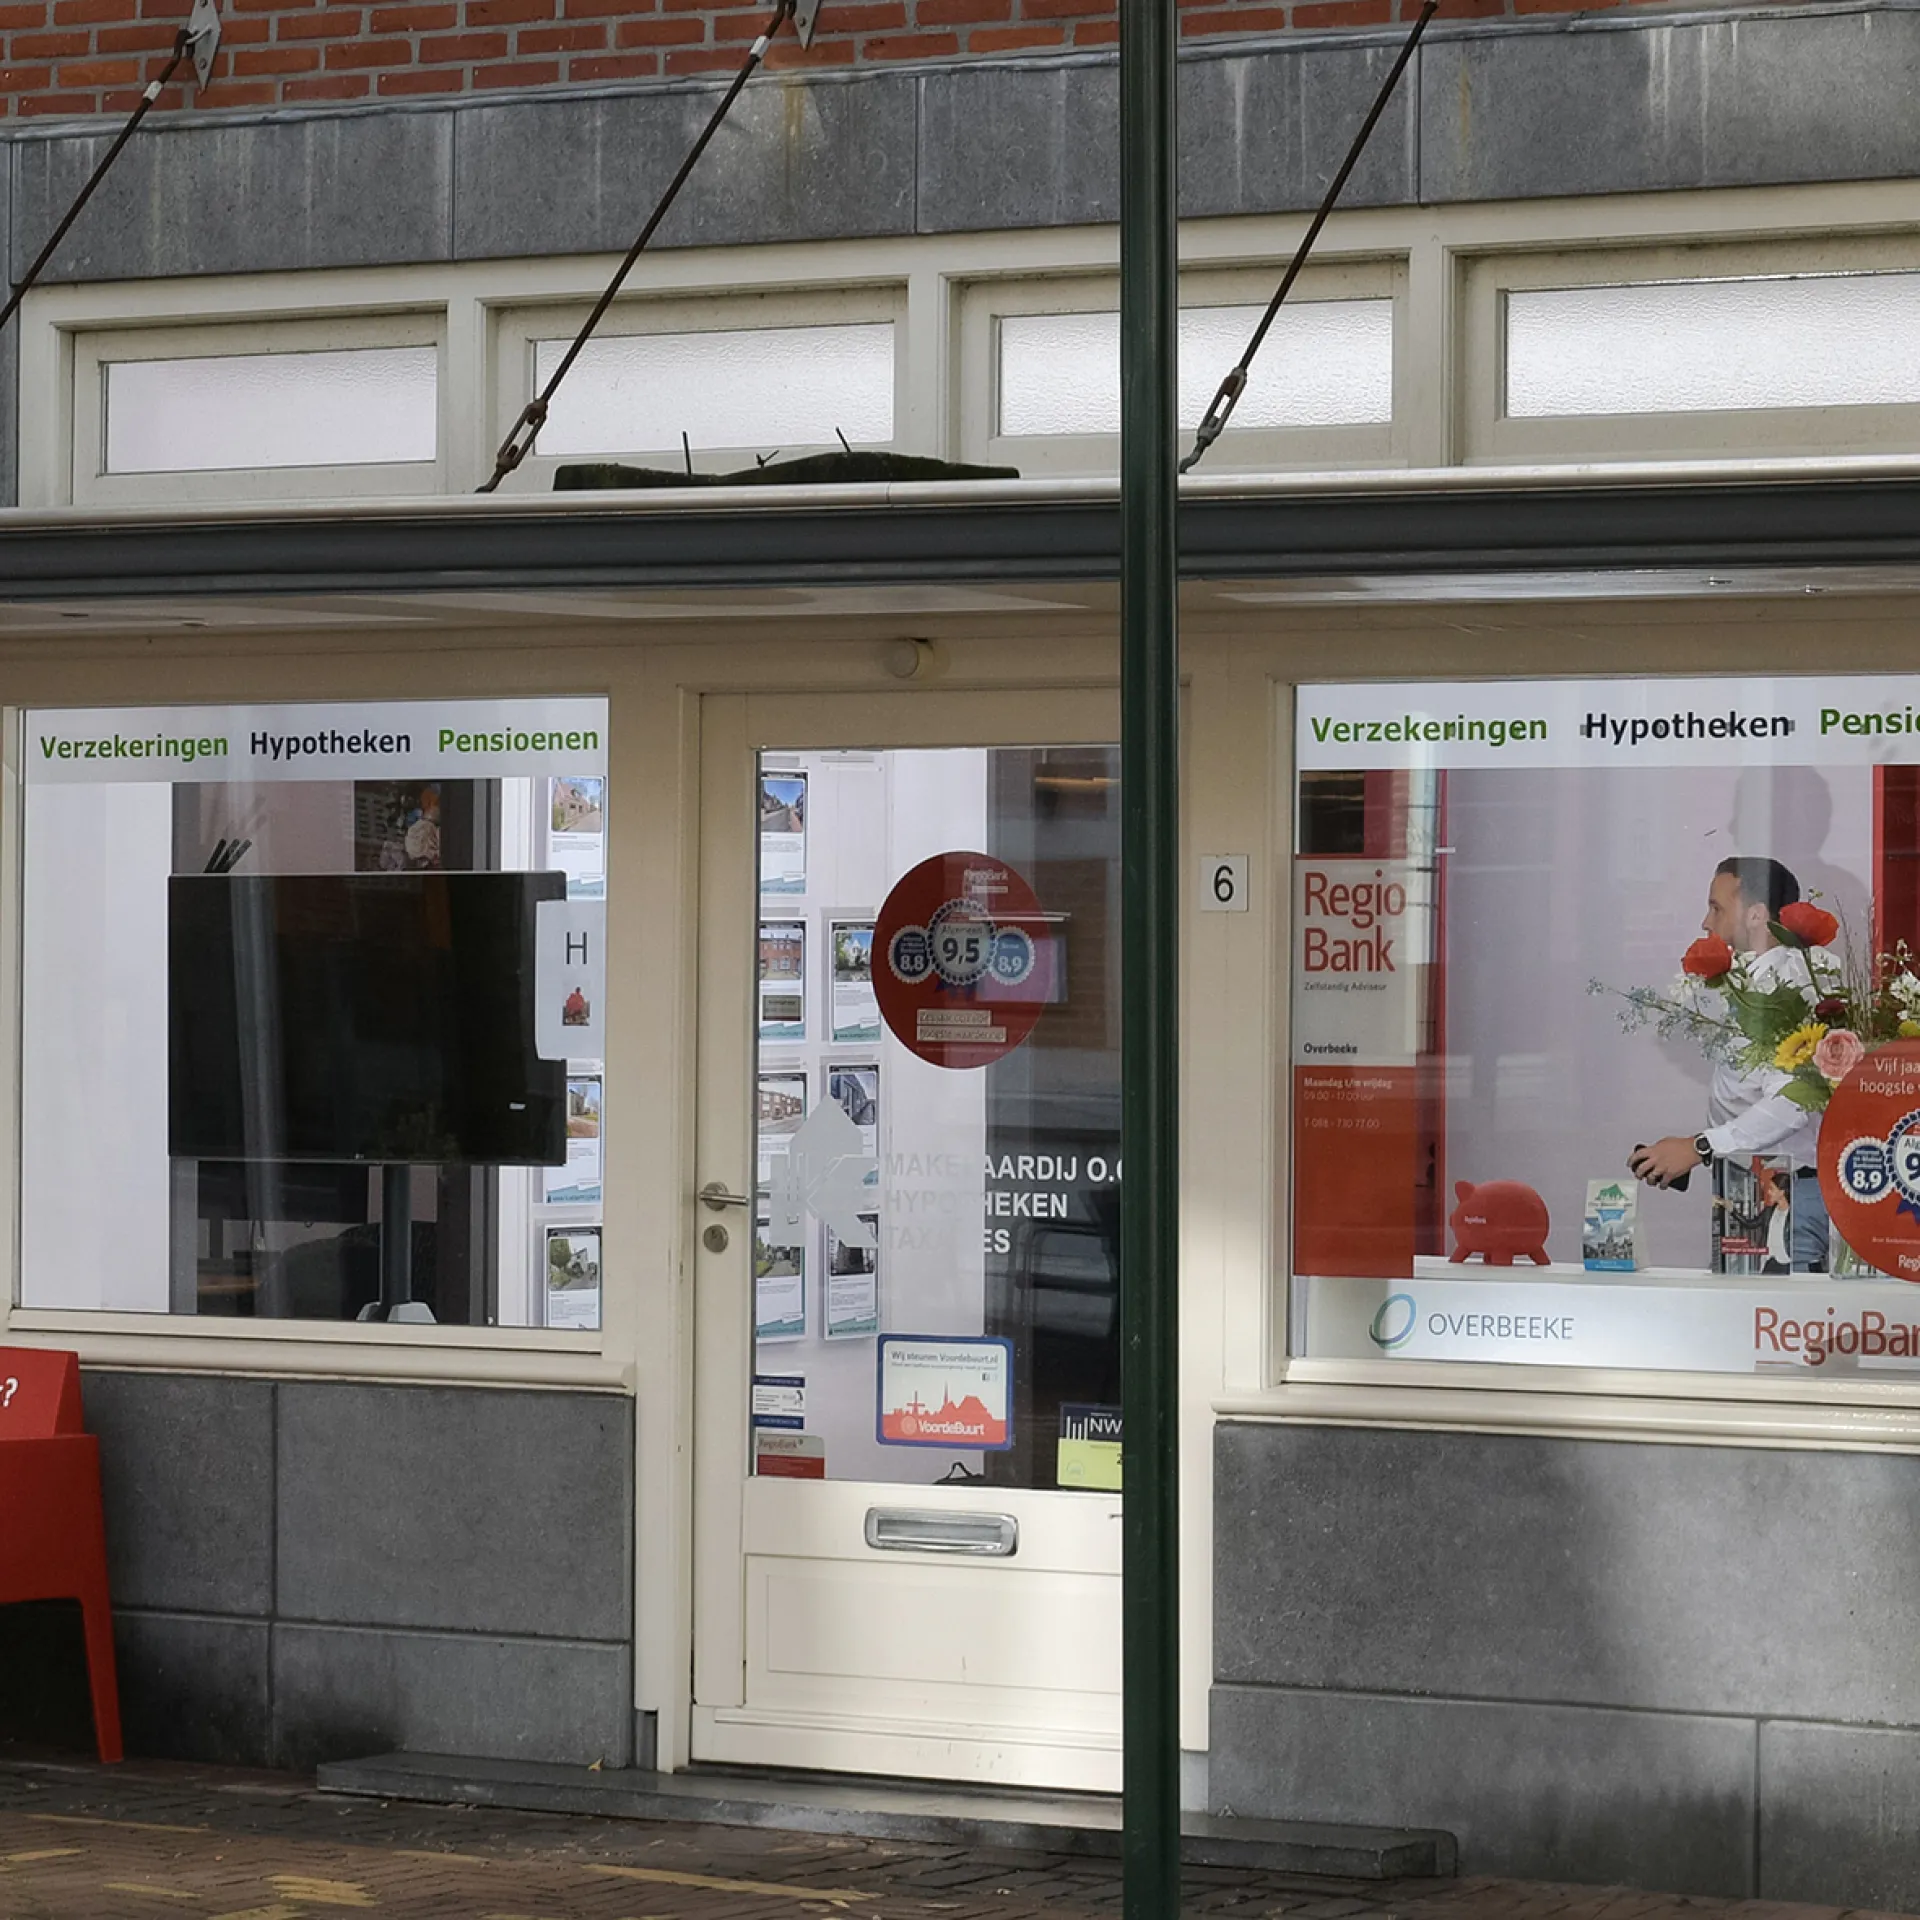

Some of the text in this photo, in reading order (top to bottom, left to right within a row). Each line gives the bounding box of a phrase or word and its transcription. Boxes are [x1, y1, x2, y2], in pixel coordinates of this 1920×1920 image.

[1310, 714, 1548, 746] Verzekeringen
[1586, 711, 1790, 745] Hypotheken
[40, 727, 599, 762] Verzekeringen Hypotheken Pensioenen
[1213, 865, 1234, 902] 6
[1303, 869, 1406, 929] Regio
[566, 931, 587, 965] H
[942, 937, 980, 965] 9,5
[1303, 925, 1395, 973] Bank
[901, 954, 925, 972] 8,8
[999, 954, 1022, 973] 8,9
[1874, 1057, 1898, 1076] Vijf
[1859, 1078, 1914, 1097] hoogste
[1852, 1170, 1882, 1191] 8,9
[1428, 1313, 1575, 1340] OVERBEEKE
